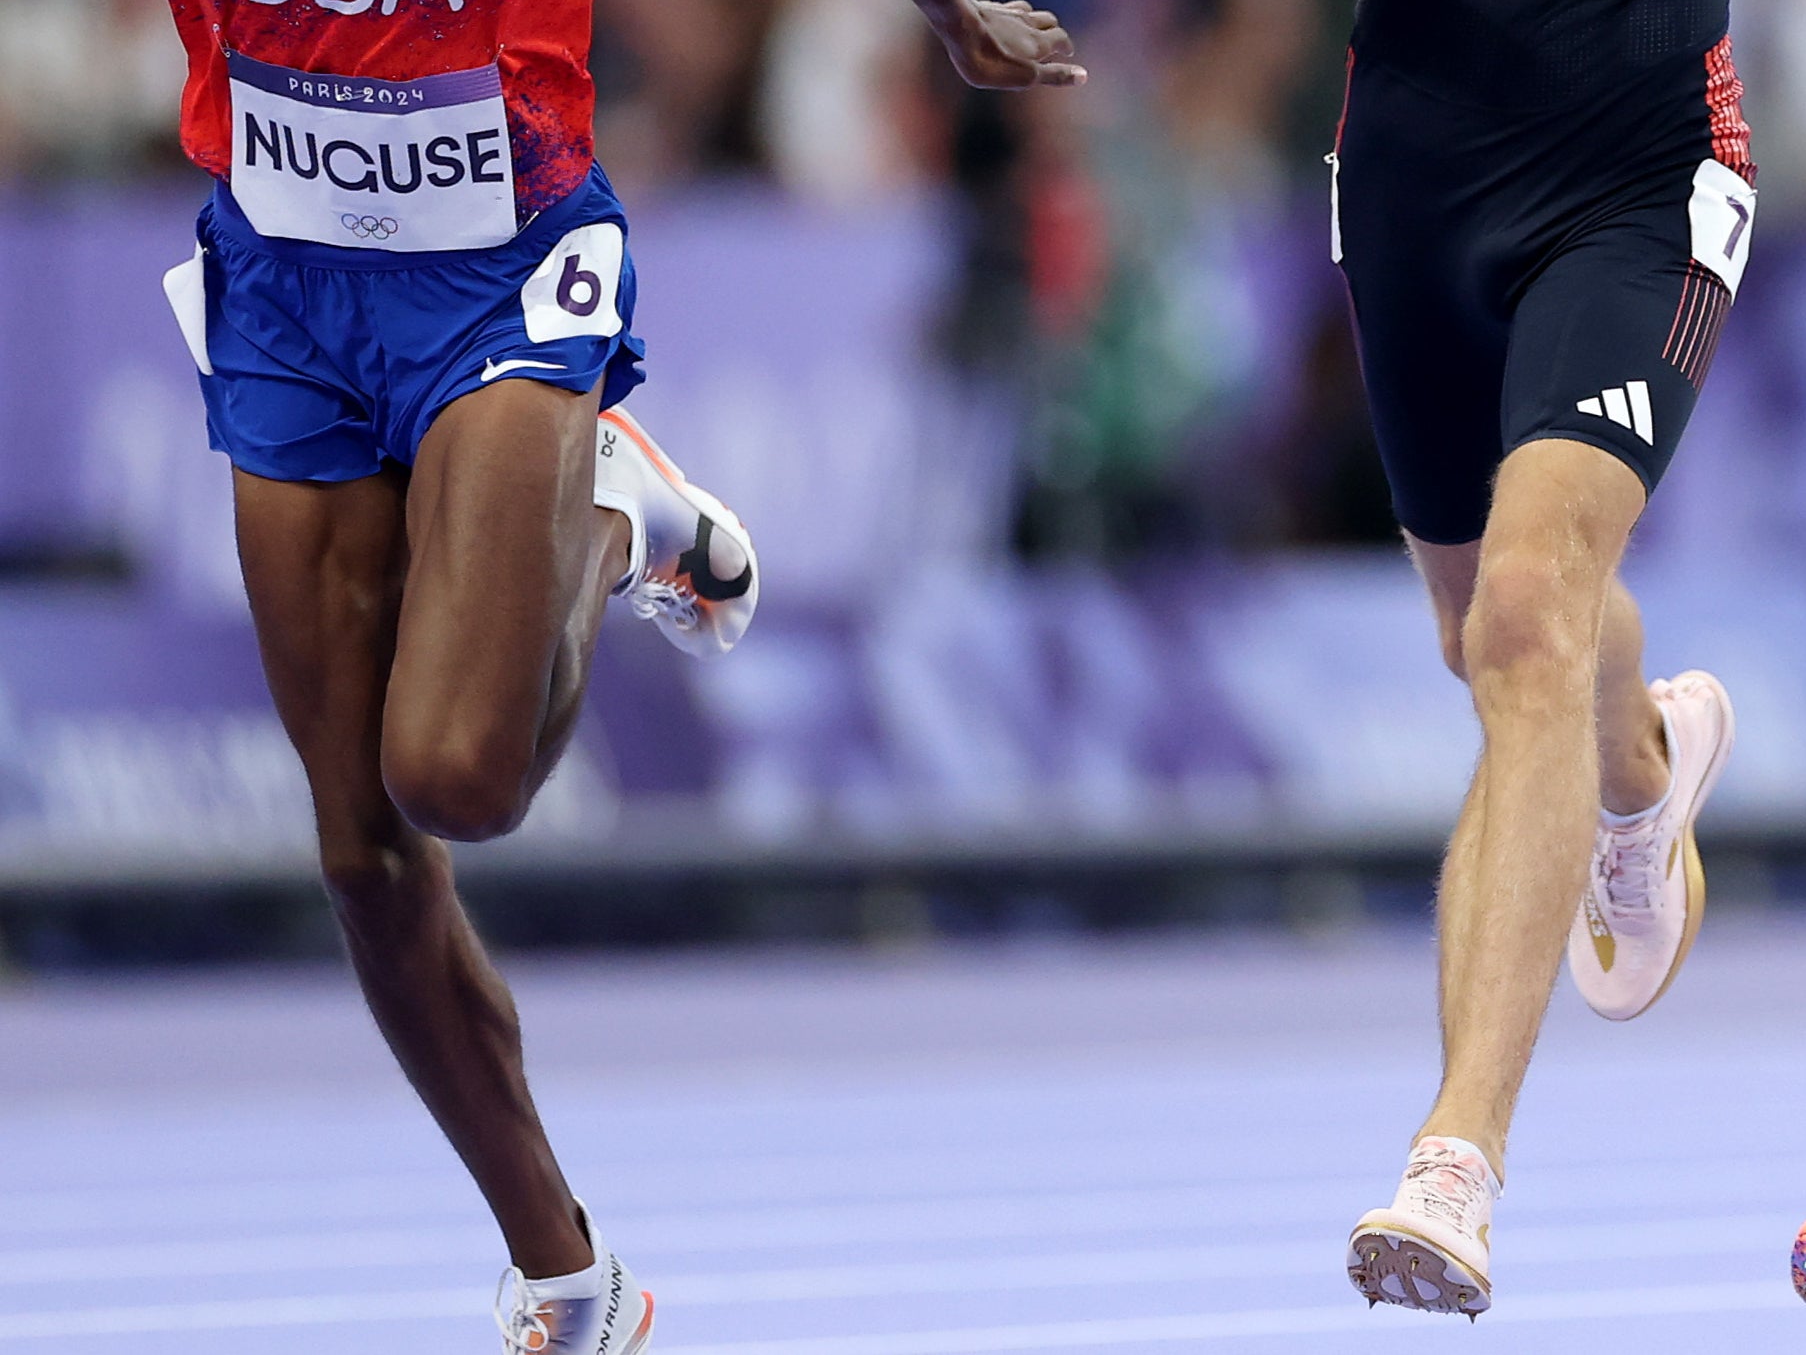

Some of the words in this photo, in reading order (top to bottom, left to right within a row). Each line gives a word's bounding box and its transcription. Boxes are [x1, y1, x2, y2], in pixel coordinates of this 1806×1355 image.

[288, 77, 352, 101] PARIS
[363, 87, 425, 105] 2024
[245, 111, 504, 194] NUGUSE
[1723, 195, 1749, 261] 7
[556, 254, 601, 316] 6
